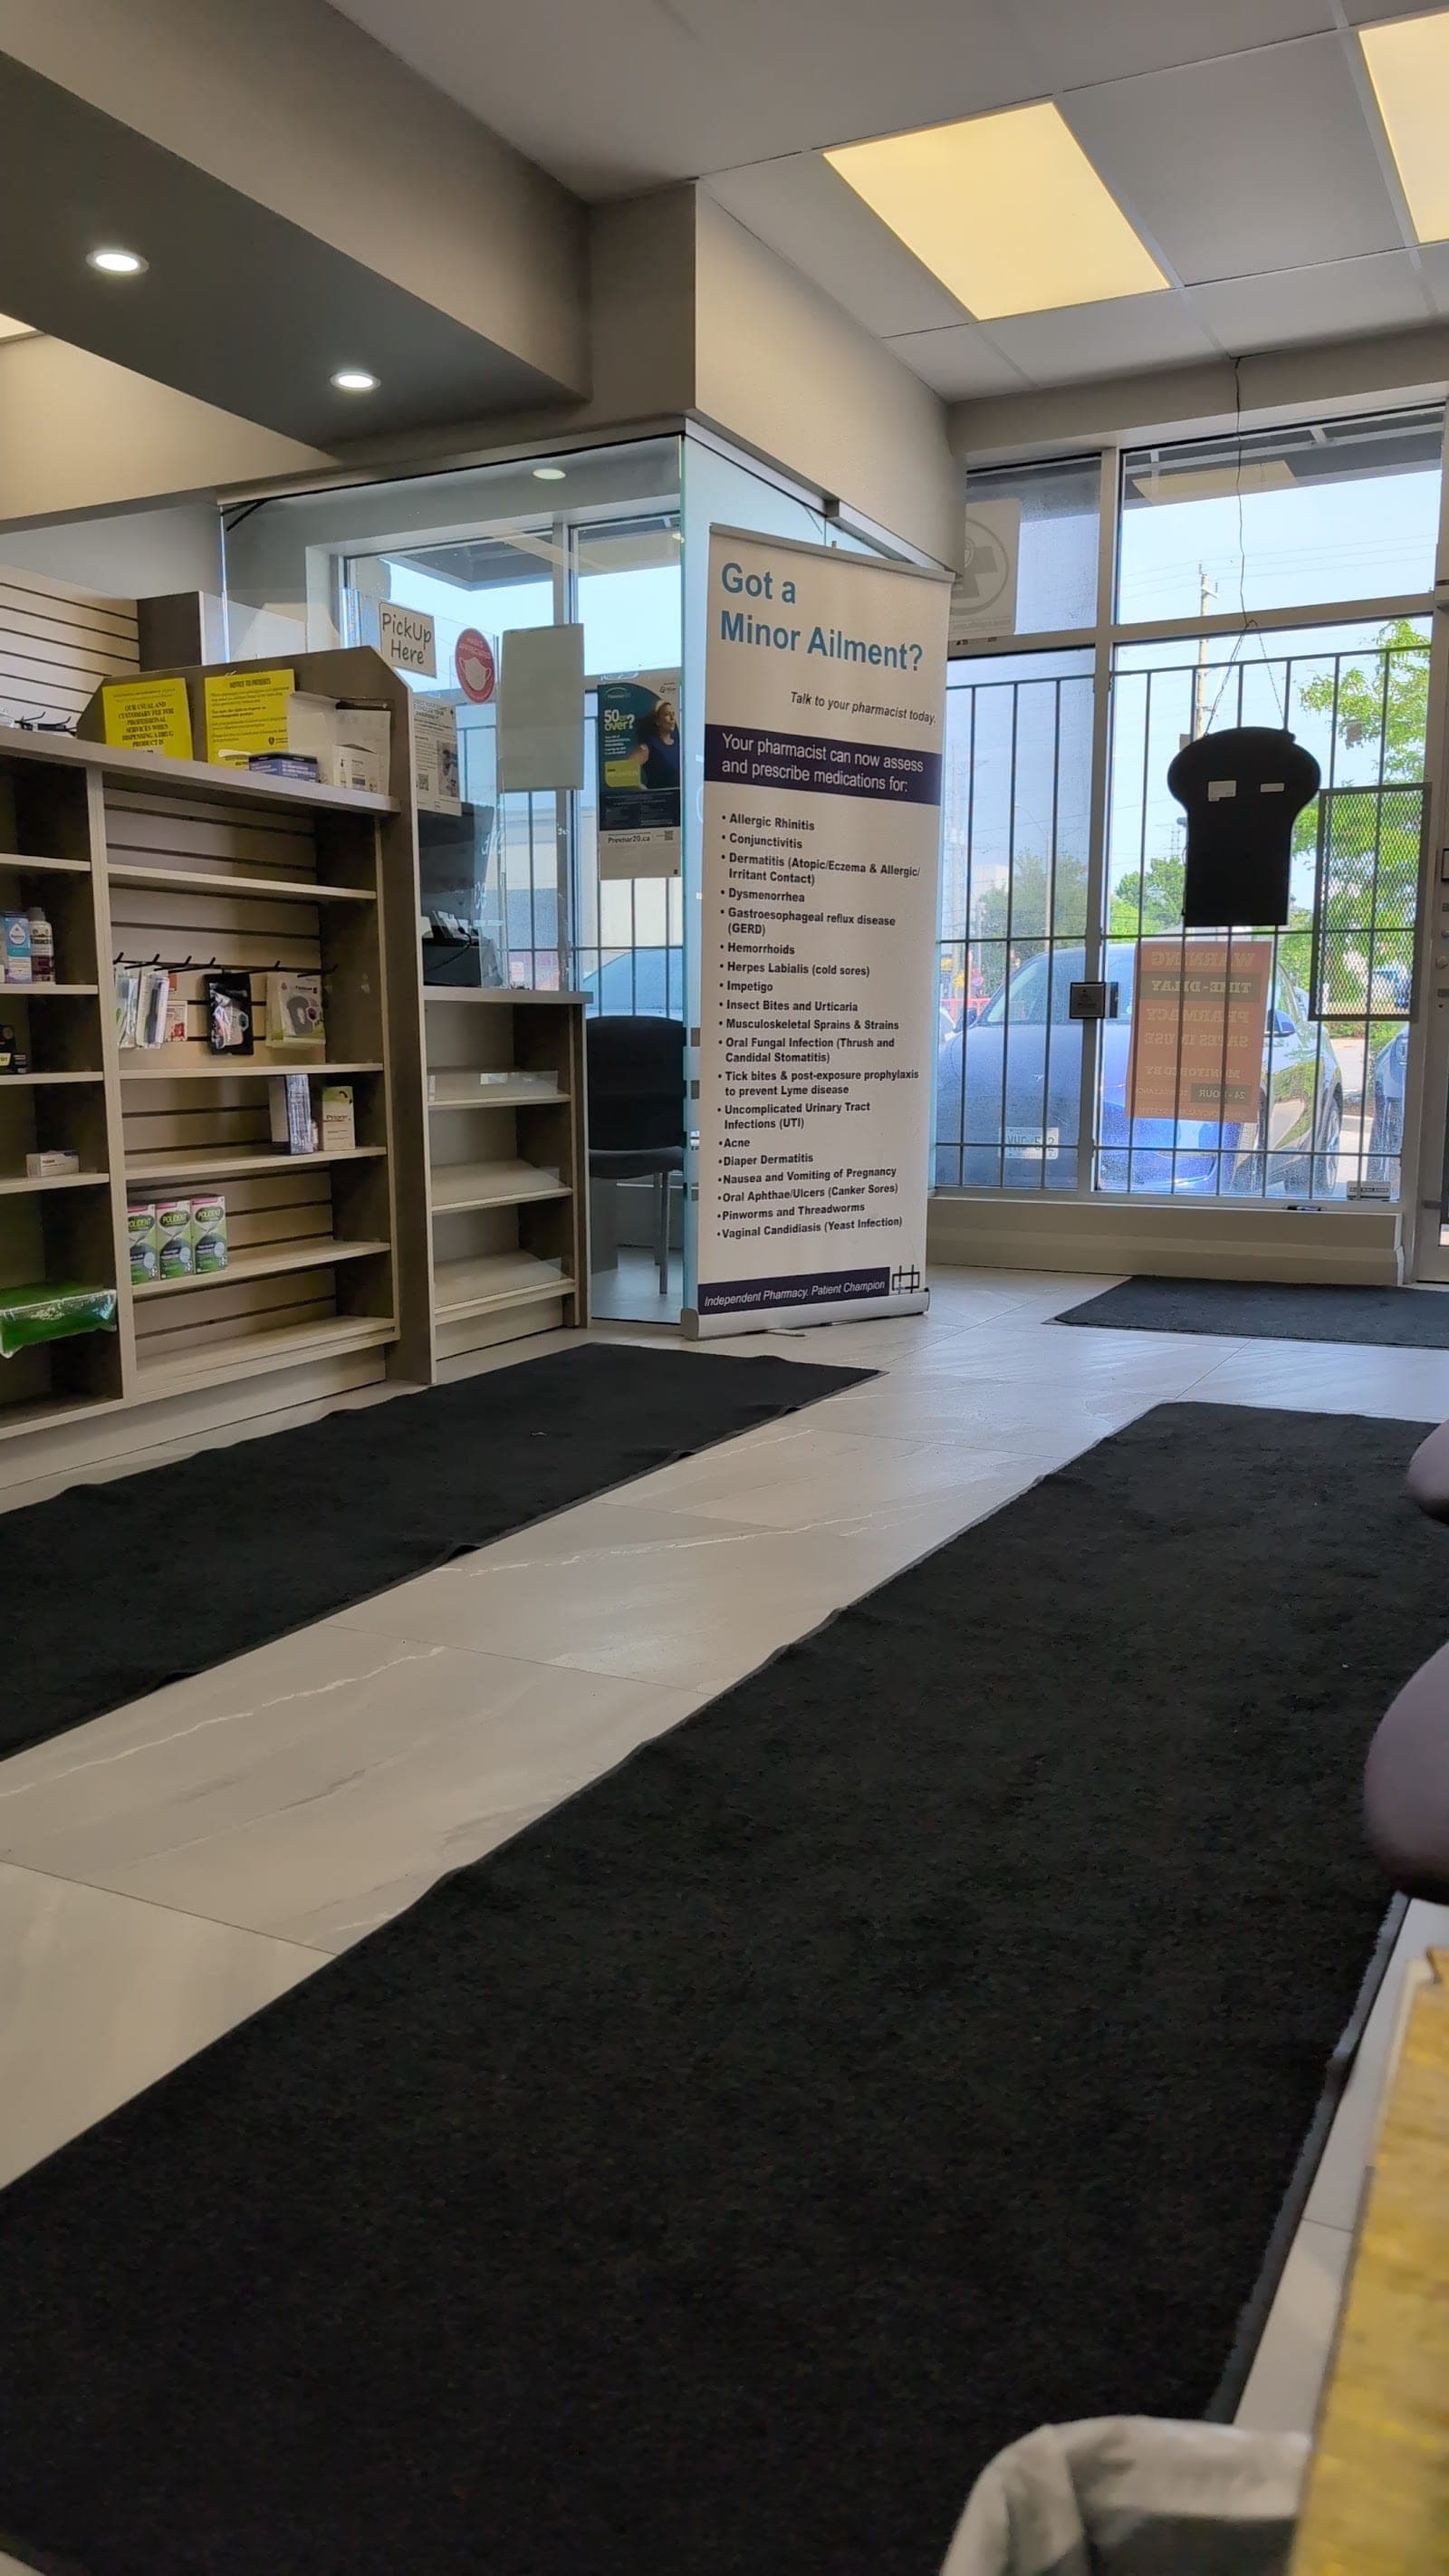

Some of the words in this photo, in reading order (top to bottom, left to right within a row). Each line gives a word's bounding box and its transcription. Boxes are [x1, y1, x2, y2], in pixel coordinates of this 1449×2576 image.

[722, 563, 772, 599] Got
[782, 581, 796, 603] a
[382, 613, 432, 649] PickUp
[721, 610, 800, 651] Minor
[807, 627, 923, 671] Ailment?
[391, 639, 424, 664] Here
[604, 709, 619, 723] 50
[791, 692, 811, 705] Talk
[815, 696, 824, 706] to
[828, 699, 849, 712] your
[852, 702, 907, 719] pharmacist
[909, 710, 936, 725] today.
[723, 733, 753, 751] Your
[758, 738, 826, 760] pharmacist
[830, 748, 850, 763] can
[855, 752, 880, 766] now
[884, 755, 923, 772] assess
[722, 759, 747, 774] and
[752, 762, 809, 781] prescribe
[814, 768, 885, 790] medications
[730, 813, 771, 828] Allergic
[775, 817, 815, 831] Rhinitis
[730, 833, 802, 849] Conjunctivitis
[730, 853, 784, 867] Dermatitis
[870, 864, 876, 873] &
[729, 868, 766, 881] Irritant
[770, 871, 815, 886] Contact)
[728, 888, 805, 902] Dysmenorrhea
[728, 907, 824, 924] Gastroesophageal
[827, 913, 854, 924] reflux
[857, 915, 895, 926] disease
[728, 923, 765, 937] (GERD)
[728, 942, 795, 954] Hemorrhoids
[727, 961, 765, 974] Herpes
[768, 963, 808, 973] Labialis
[812, 964, 837, 977] (cold
[840, 965, 870, 978] sores)
[727, 981, 773, 993] Impetigo
[727, 1000, 759, 1010] Insect
[763, 1000, 789, 1010] Bites
[793, 1001, 811, 1011] and
[815, 1001, 858, 1011] Urticaria
[726, 1019, 810, 1029] Musculoskeletal
[814, 1020, 850, 1031] Sprains
[854, 1021, 860, 1029] &
[864, 1020, 899, 1030] Strains
[726, 1038, 747, 1047] Oral
[752, 1037, 785, 1050] Fungal
[789, 1037, 833, 1047] Infection
[837, 1037, 873, 1049] (Thrush
[877, 1038, 894, 1047] and
[726, 1053, 770, 1062] Candidal
[774, 1052, 830, 1064] Stomatitis)
[725, 1071, 748, 1081] Tick
[752, 1071, 776, 1080] bites
[780, 1071, 787, 1080] &
[791, 1071, 861, 1083] post-exposure
[864, 1069, 919, 1082] prophylaxis
[725, 1087, 735, 1096] to
[739, 1087, 777, 1098] prevent
[781, 1086, 808, 1097] Lyme
[811, 1086, 849, 1095] disease
[725, 1104, 802, 1116] Uncomplicated
[805, 1103, 841, 1114] Urinary
[845, 1102, 870, 1111] Tract
[725, 1119, 776, 1129] Infections
[779, 1118, 804, 1130] (UTI)
[724, 1138, 750, 1147] Acne
[724, 1156, 757, 1167] Diaper
[761, 1153, 813, 1164] Dermatitis
[723, 1175, 762, 1184] Nausea
[765, 1172, 783, 1182] and
[787, 1170, 830, 1182] Vomiting
[833, 1169, 843, 1178] of
[846, 1167, 897, 1178] Pregnancy
[723, 1193, 744, 1202] Oral
[828, 1186, 865, 1198] (Canker
[868, 1183, 898, 1194] Sores)
[723, 1210, 773, 1221] Pinworms
[776, 1207, 795, 1217] and
[798, 1203, 865, 1216] Threadworms
[129, 1218, 151, 1227] OLIDENT
[722, 1227, 760, 1239] Vaginal
[764, 1223, 821, 1235] Candidiasis
[824, 1221, 854, 1233] (Yeast
[858, 1216, 902, 1229] Infection)
[705, 1291, 761, 1306] Independent
[811, 1285, 841, 1295] Patient
[843, 1281, 885, 1293] Champion
